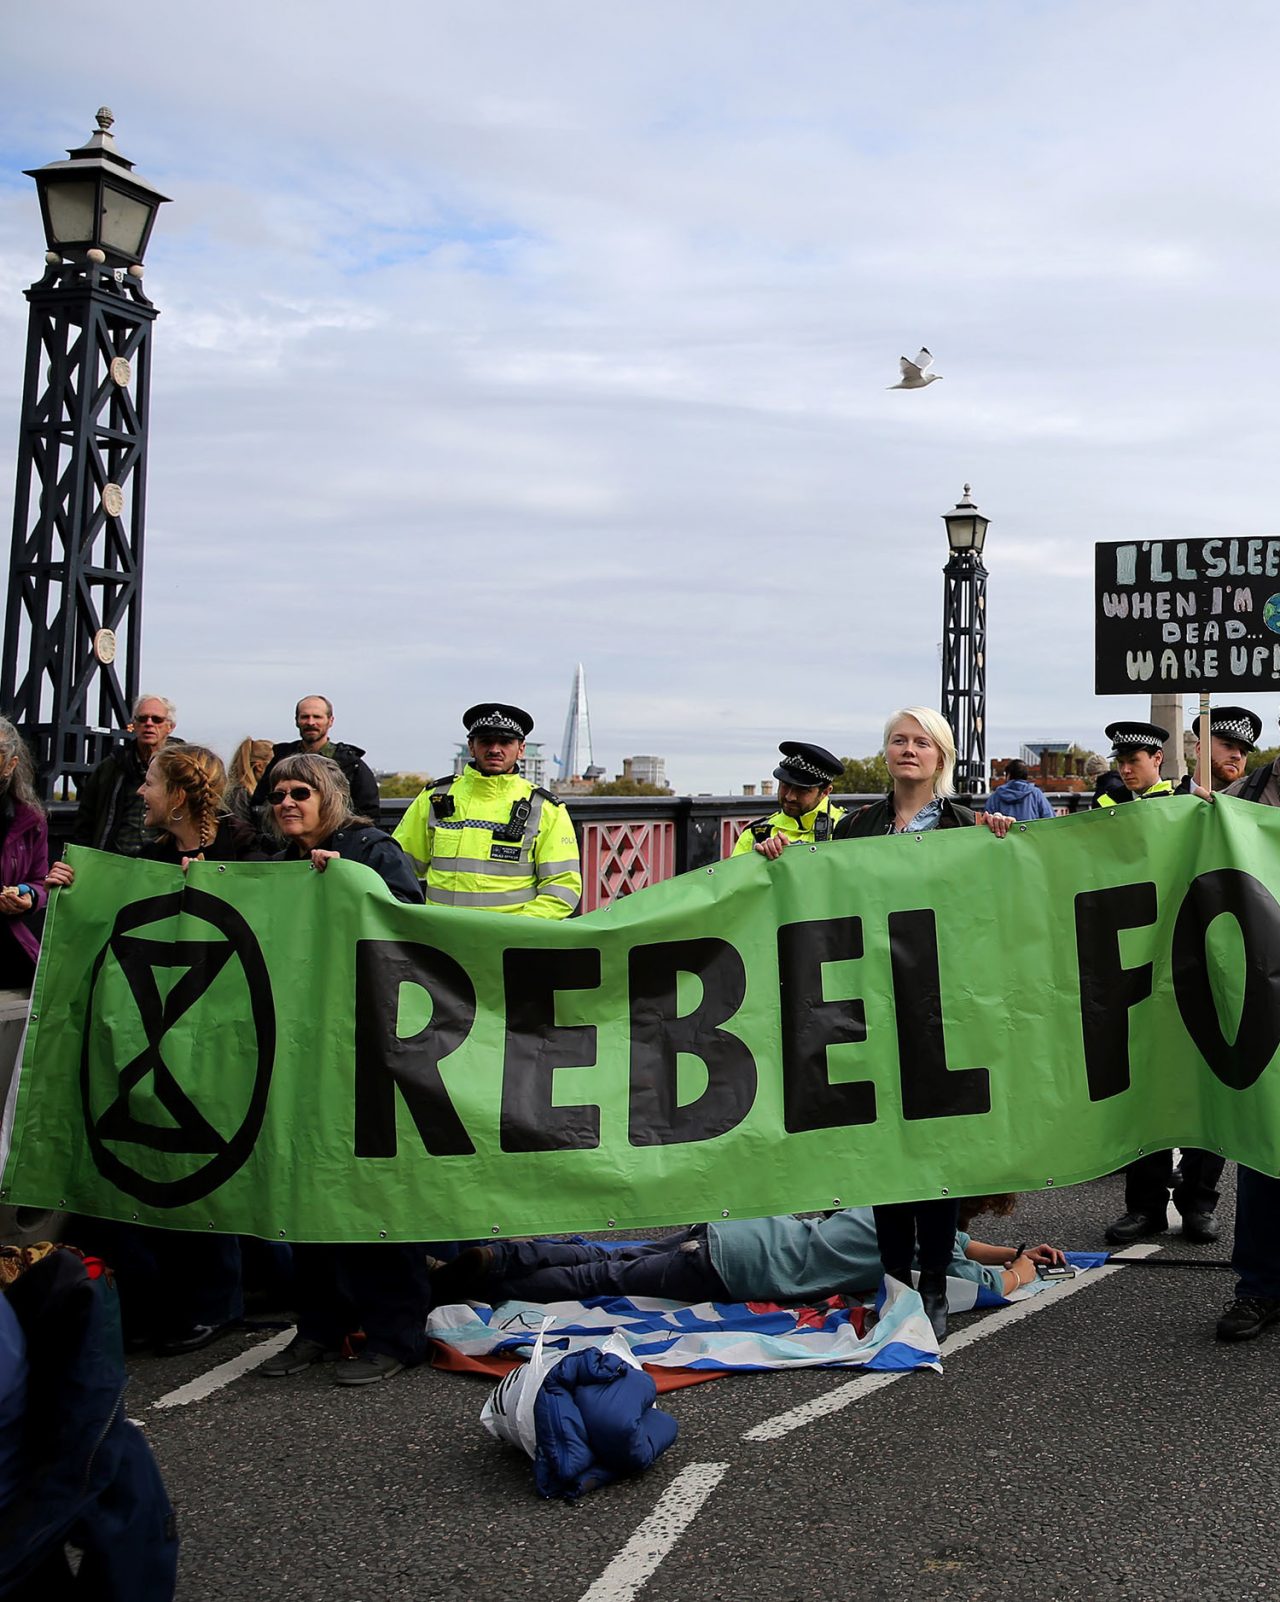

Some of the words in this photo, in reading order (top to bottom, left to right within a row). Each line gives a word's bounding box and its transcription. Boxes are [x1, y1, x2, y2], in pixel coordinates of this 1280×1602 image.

[1116, 541, 1197, 585] I'LL
[1103, 591, 1197, 619] WHEN
[1210, 586, 1253, 615] I'M
[1126, 649, 1218, 681] WAKE
[354, 908, 992, 1158] REBEL
